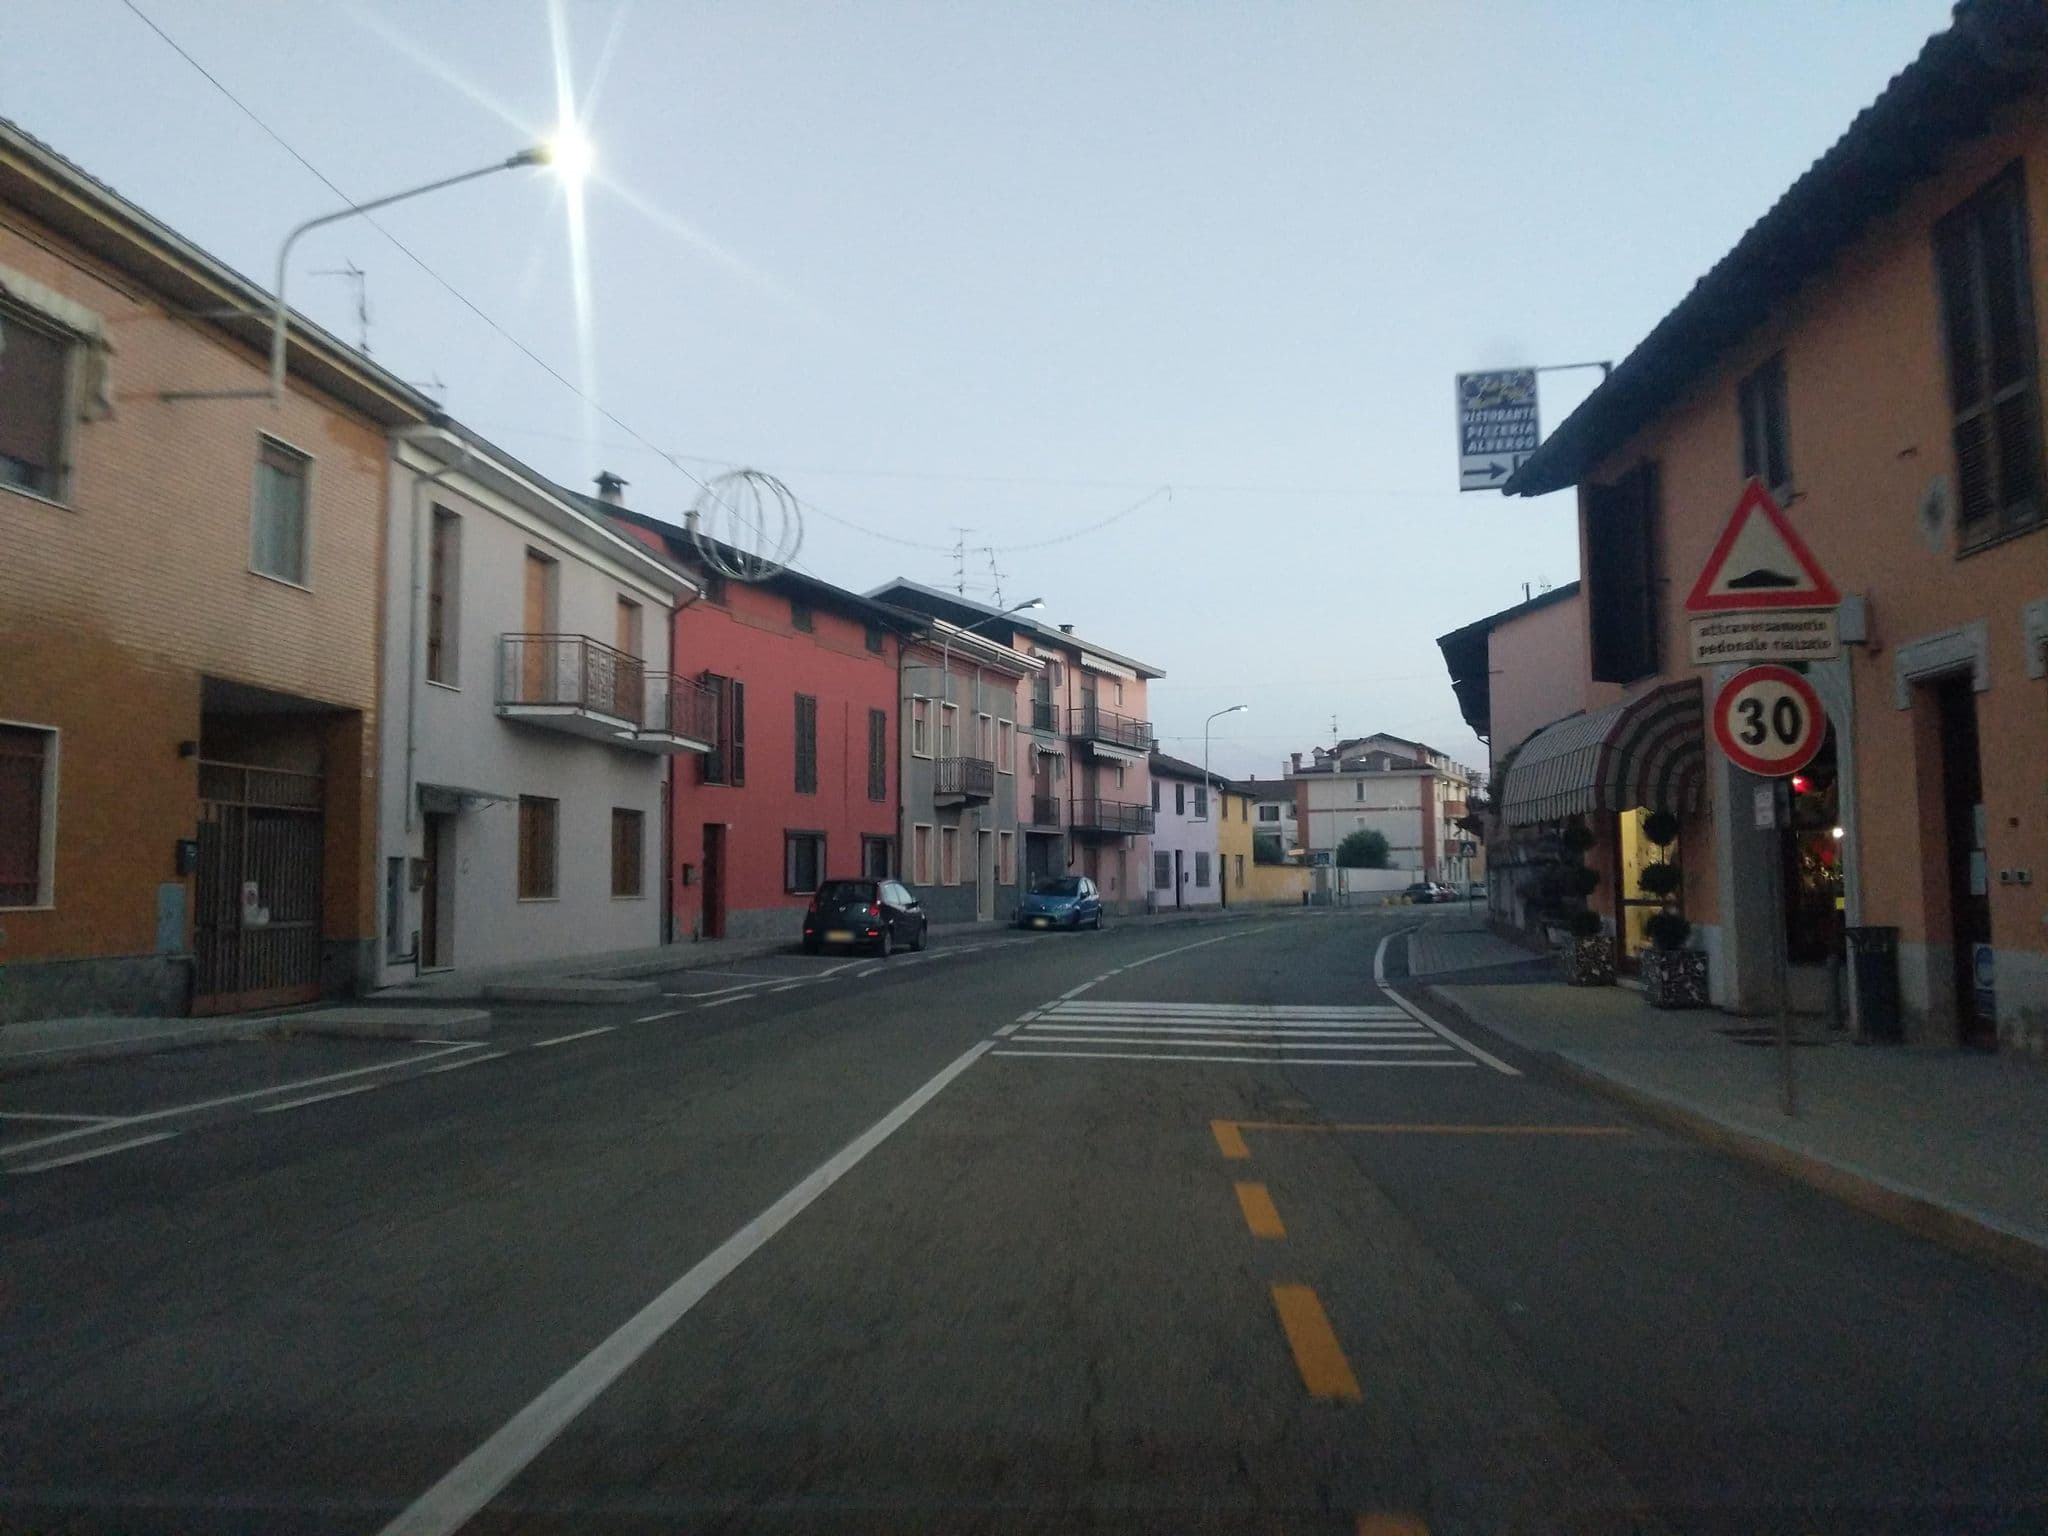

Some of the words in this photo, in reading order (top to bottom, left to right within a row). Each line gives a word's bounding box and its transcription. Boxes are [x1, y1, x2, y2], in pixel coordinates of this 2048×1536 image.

[1466, 422, 1534, 438] PIZZERIA
[1467, 436, 1534, 453] ALBERGO
[1699, 619, 1826, 636] attraversamento
[1698, 638, 1768, 657] pedonale
[1739, 695, 1803, 746] 30
